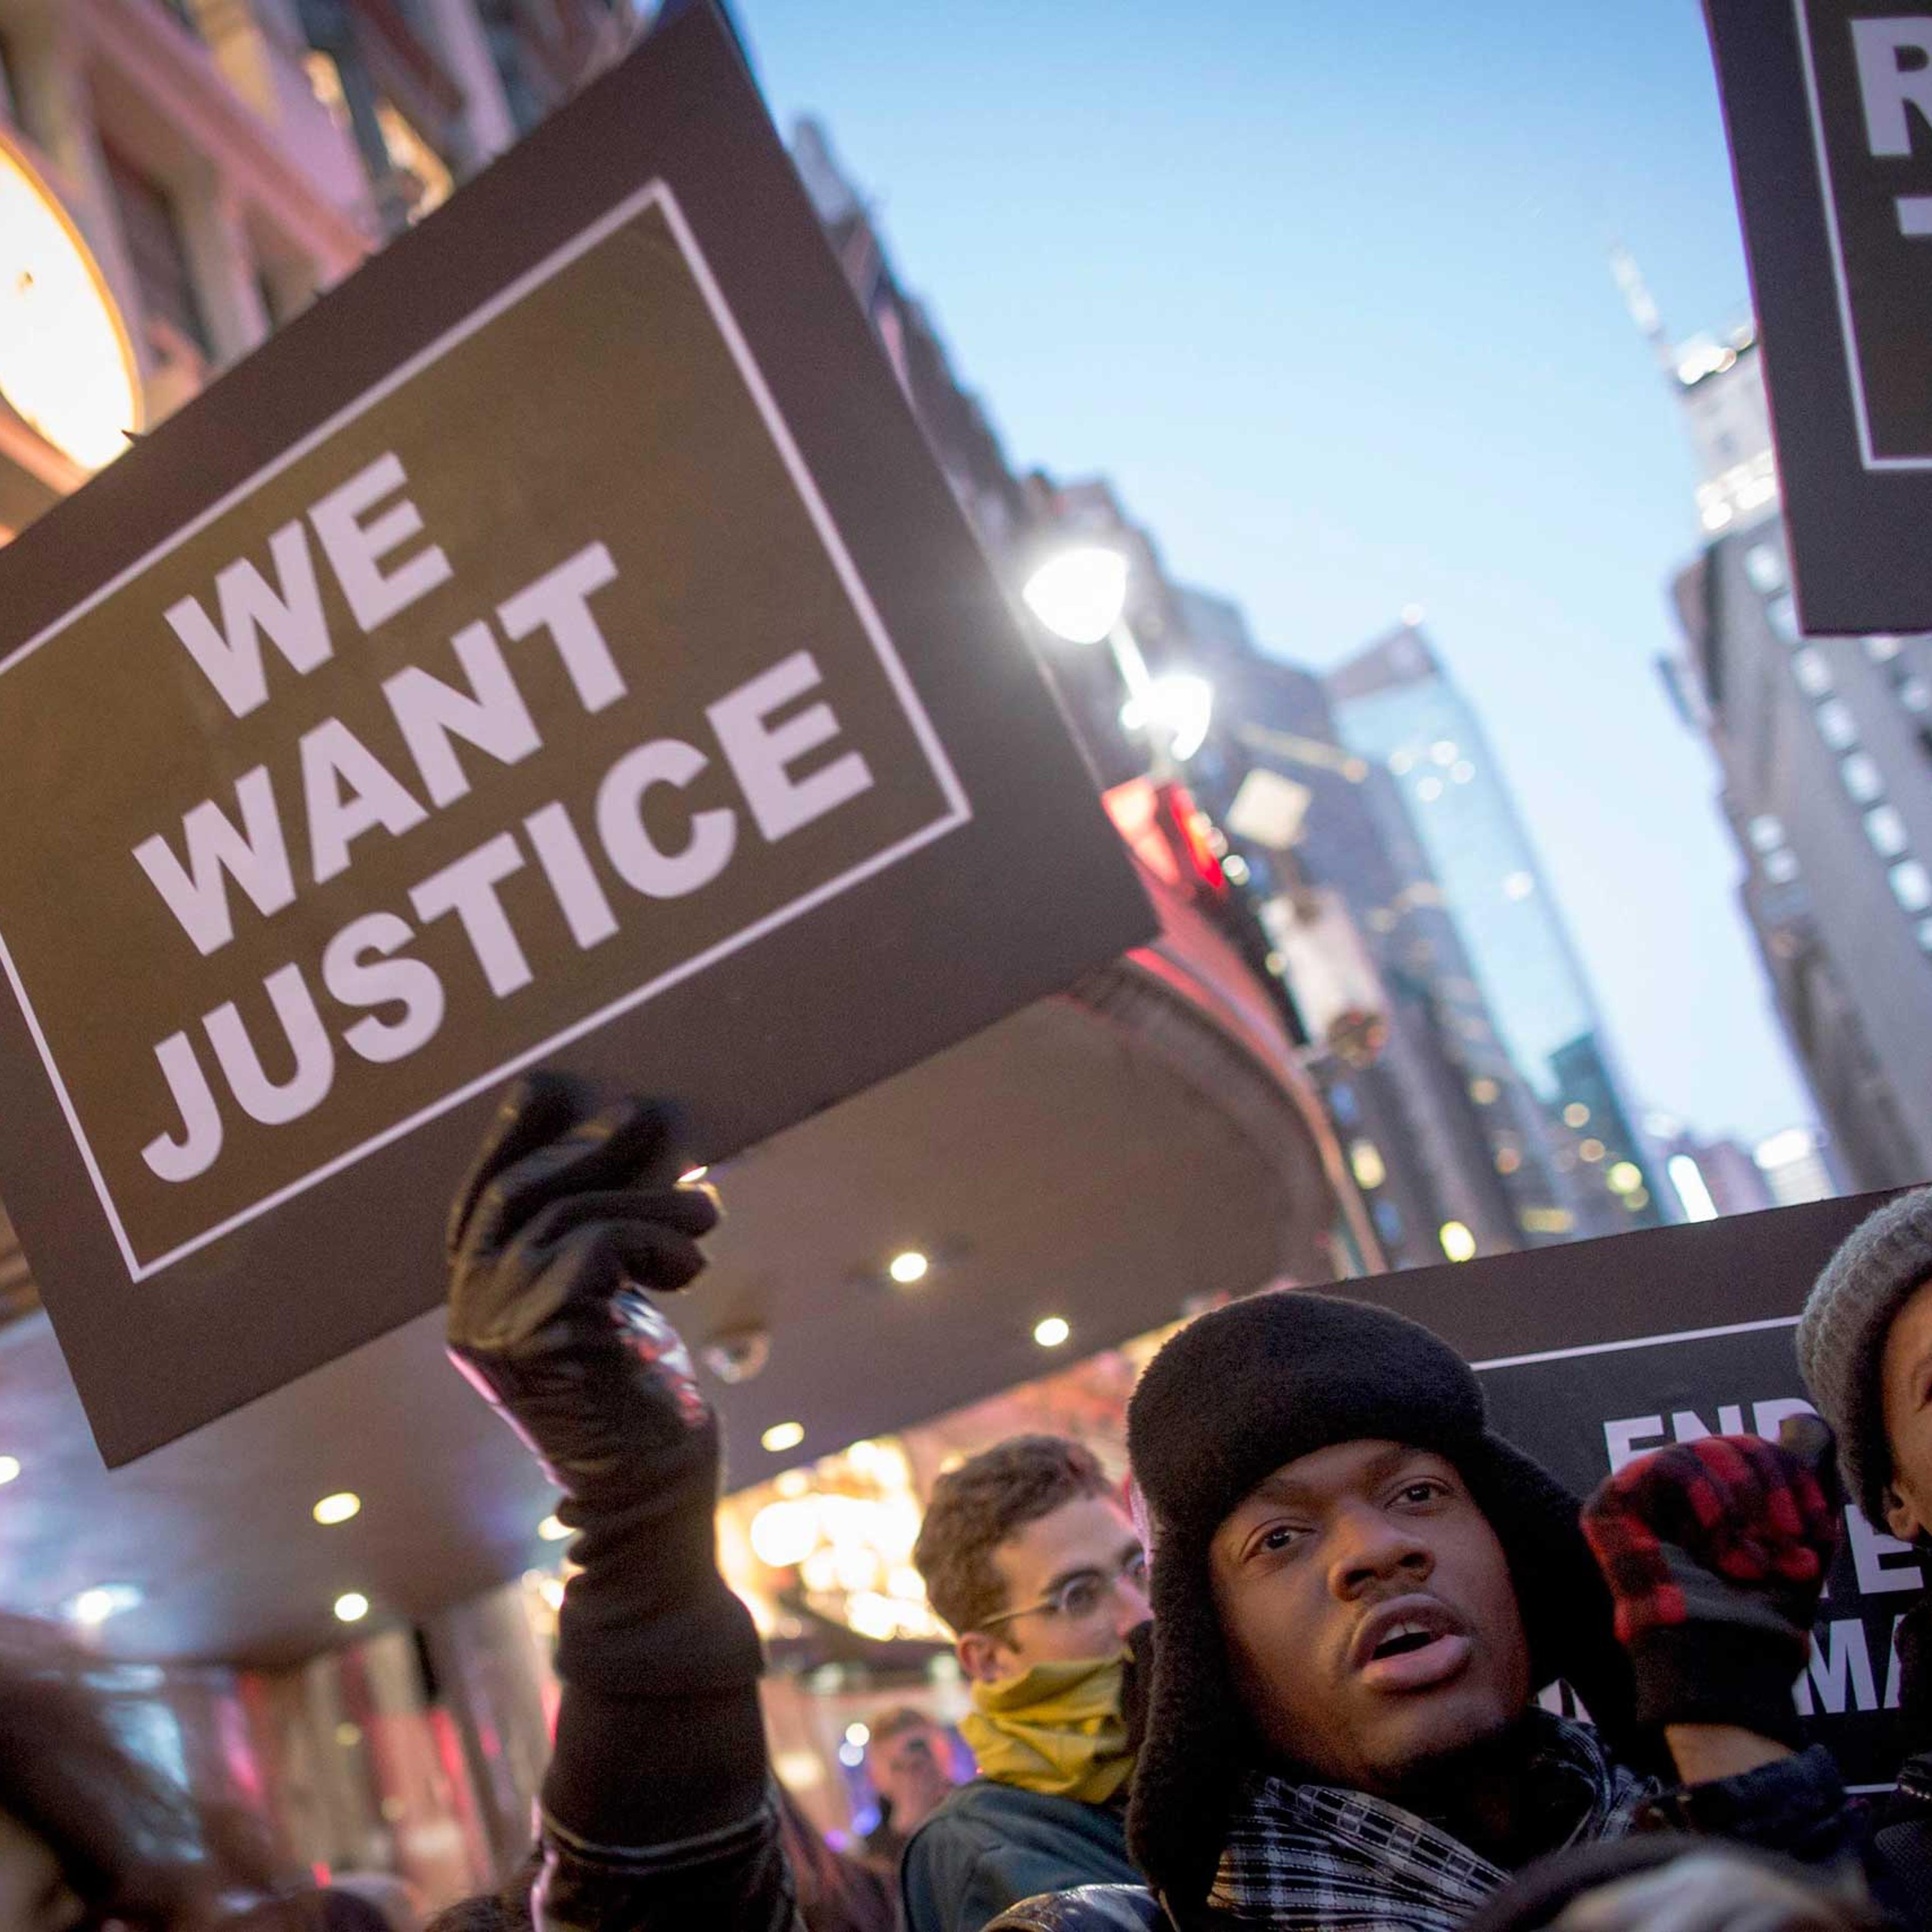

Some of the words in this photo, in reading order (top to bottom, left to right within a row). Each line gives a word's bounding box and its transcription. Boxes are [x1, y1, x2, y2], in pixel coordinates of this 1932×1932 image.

[132, 542, 627, 956] WANT
[164, 452, 452, 718] WE
[141, 651, 873, 1182] JUSTICE
